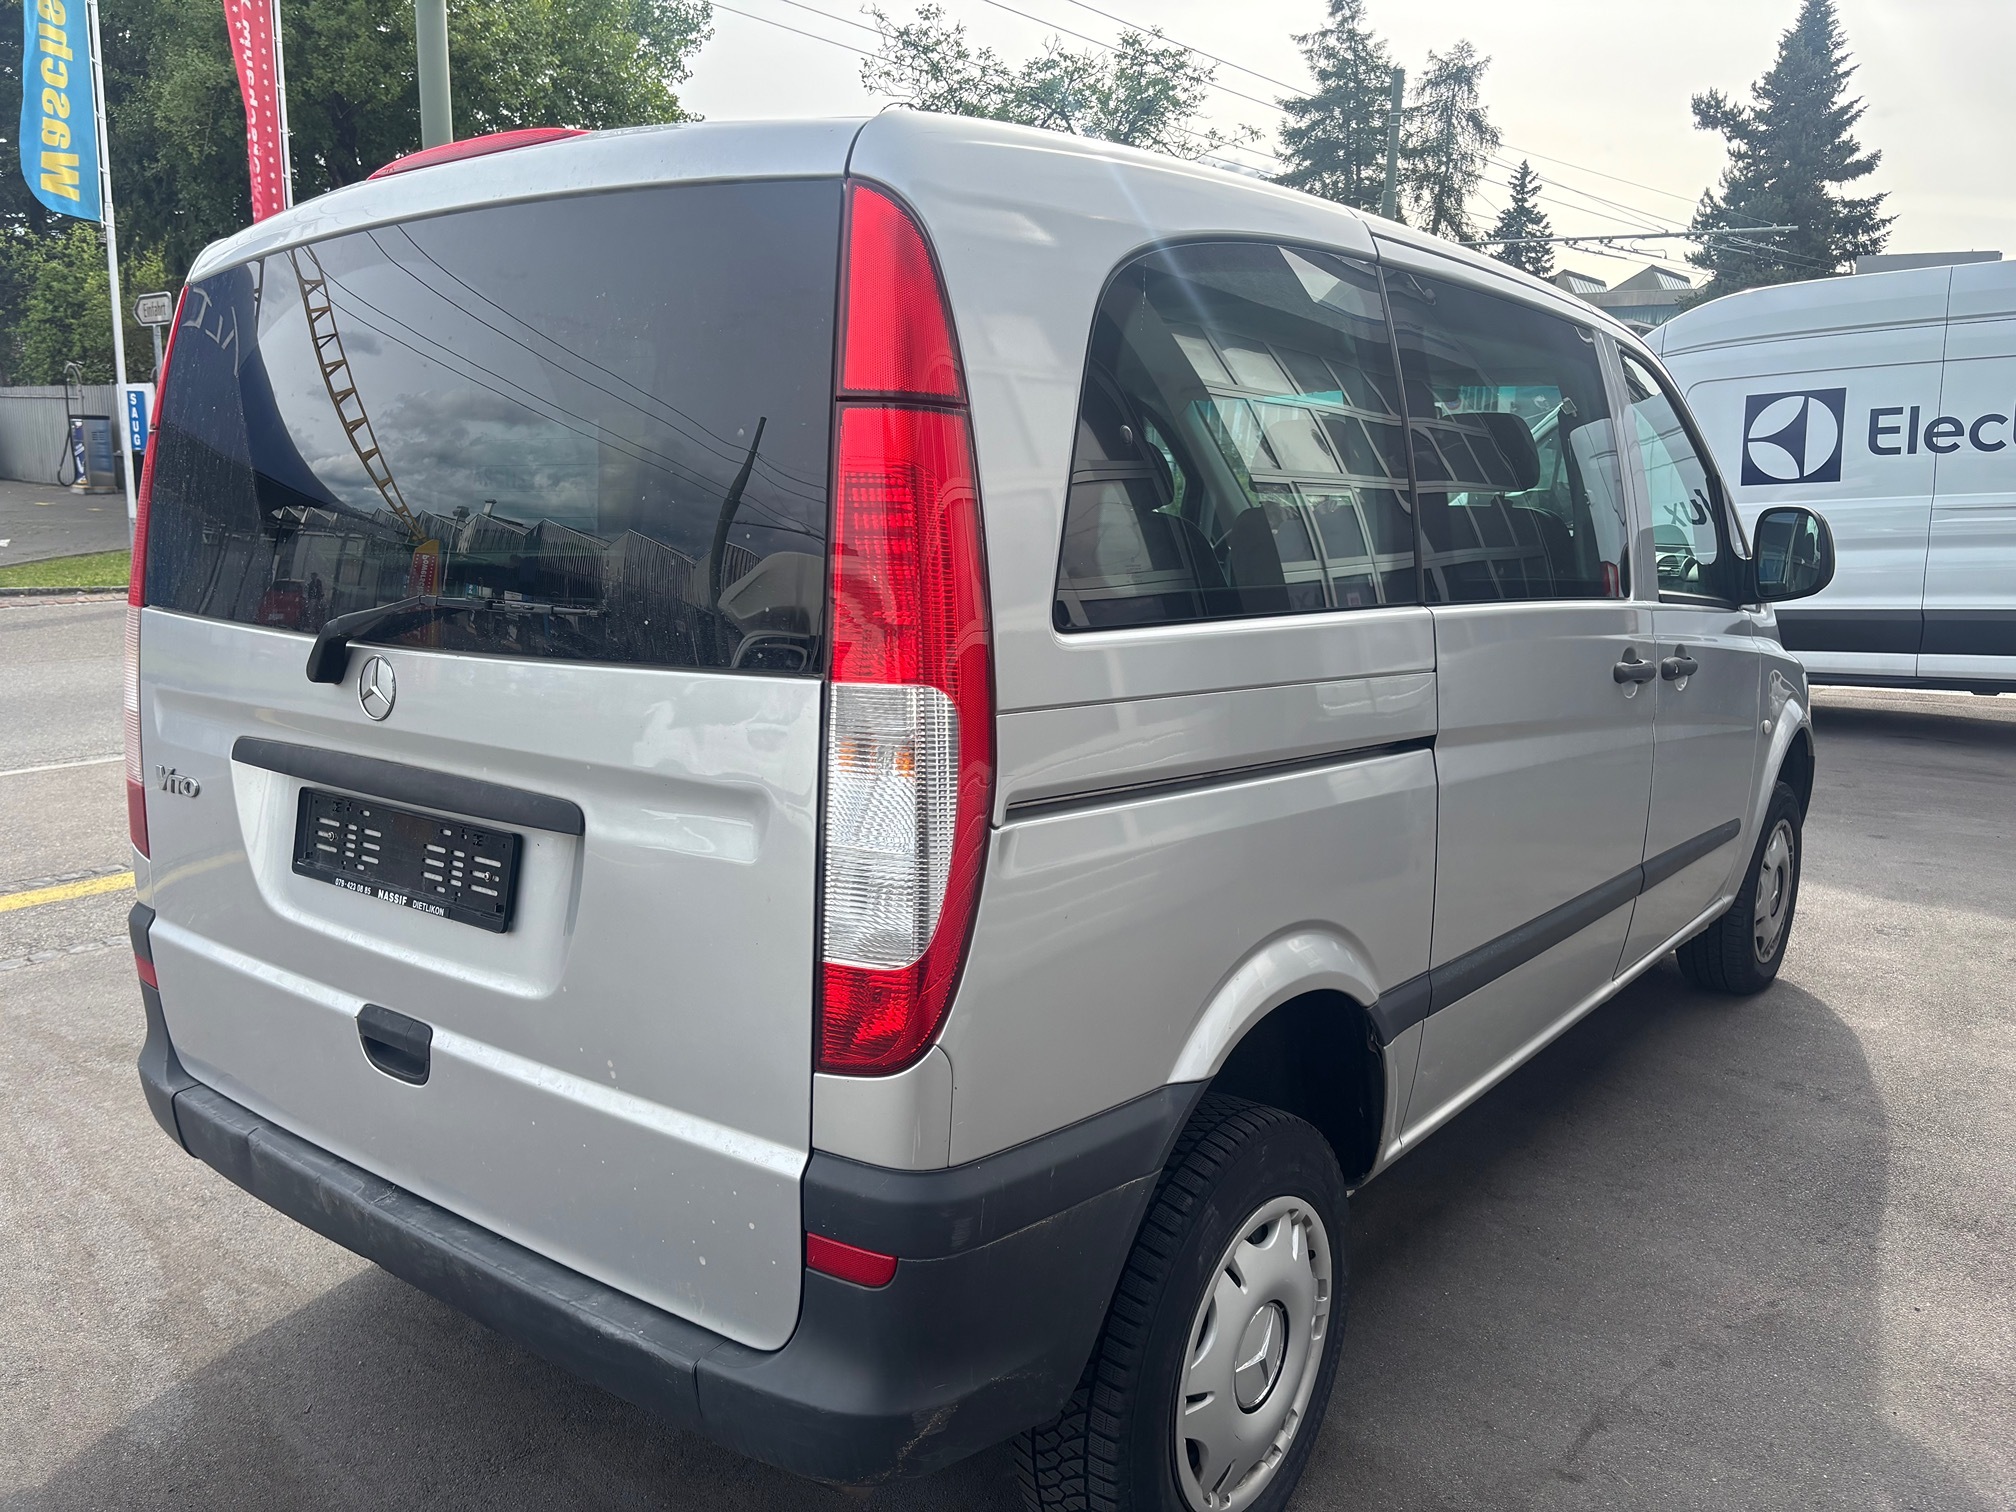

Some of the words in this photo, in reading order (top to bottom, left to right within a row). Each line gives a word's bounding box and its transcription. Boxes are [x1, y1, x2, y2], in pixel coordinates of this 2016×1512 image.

[142, 301, 167, 318] Einfahrt
[130, 393, 141, 451] SAUG
[1868, 403, 2016, 456] Elec
[357, 884, 364, 893] 08
[364, 886, 371, 895] 85
[377, 889, 407, 905] NASSIF
[412, 900, 445, 916] DIETLIKON
